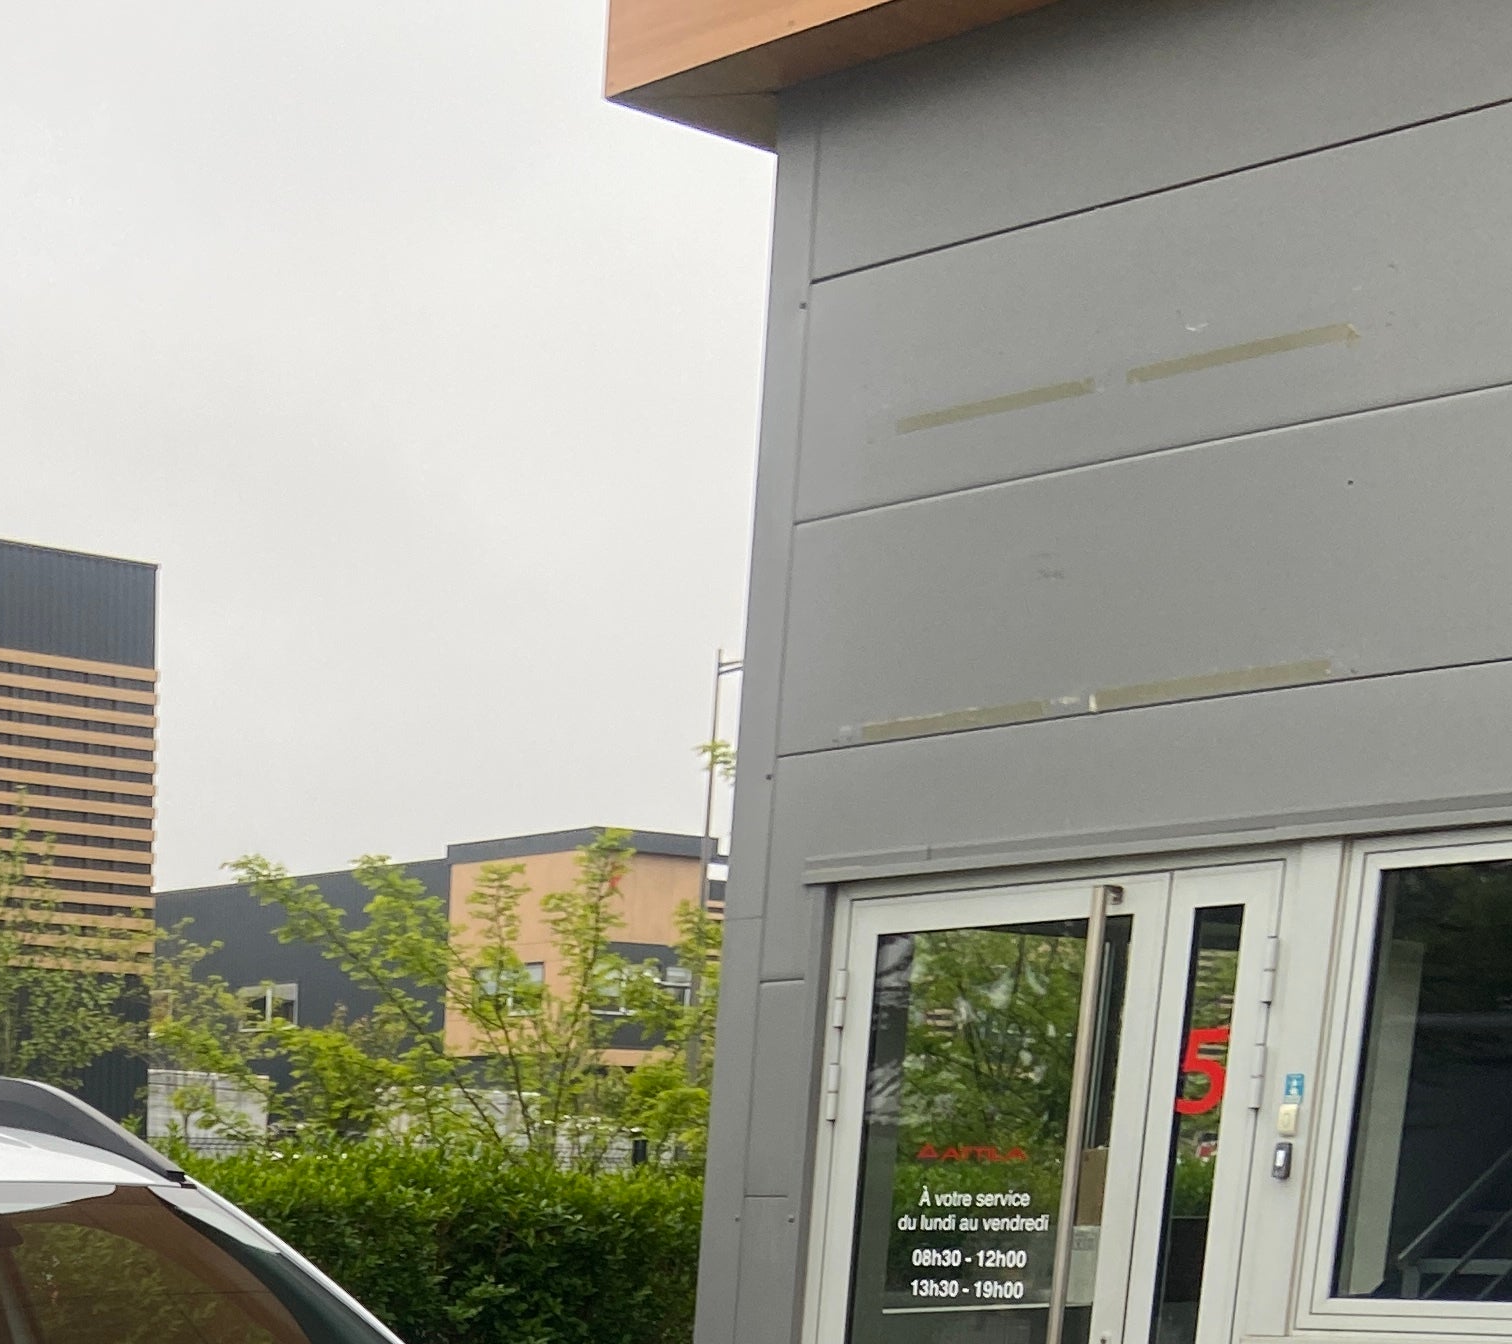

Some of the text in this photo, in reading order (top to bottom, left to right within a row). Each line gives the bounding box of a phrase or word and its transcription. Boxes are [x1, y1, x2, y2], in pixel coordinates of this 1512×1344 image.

[1174, 1025, 1230, 1115] 5
[918, 1185, 1031, 1207] À votre service
[897, 1214, 1050, 1232] du lundi au vendredi
[912, 1249, 962, 1267] 08h30
[976, 1249, 1028, 1269] 12h00
[910, 1279, 959, 1298] 13h30
[974, 1280, 1025, 1299] 19h00
